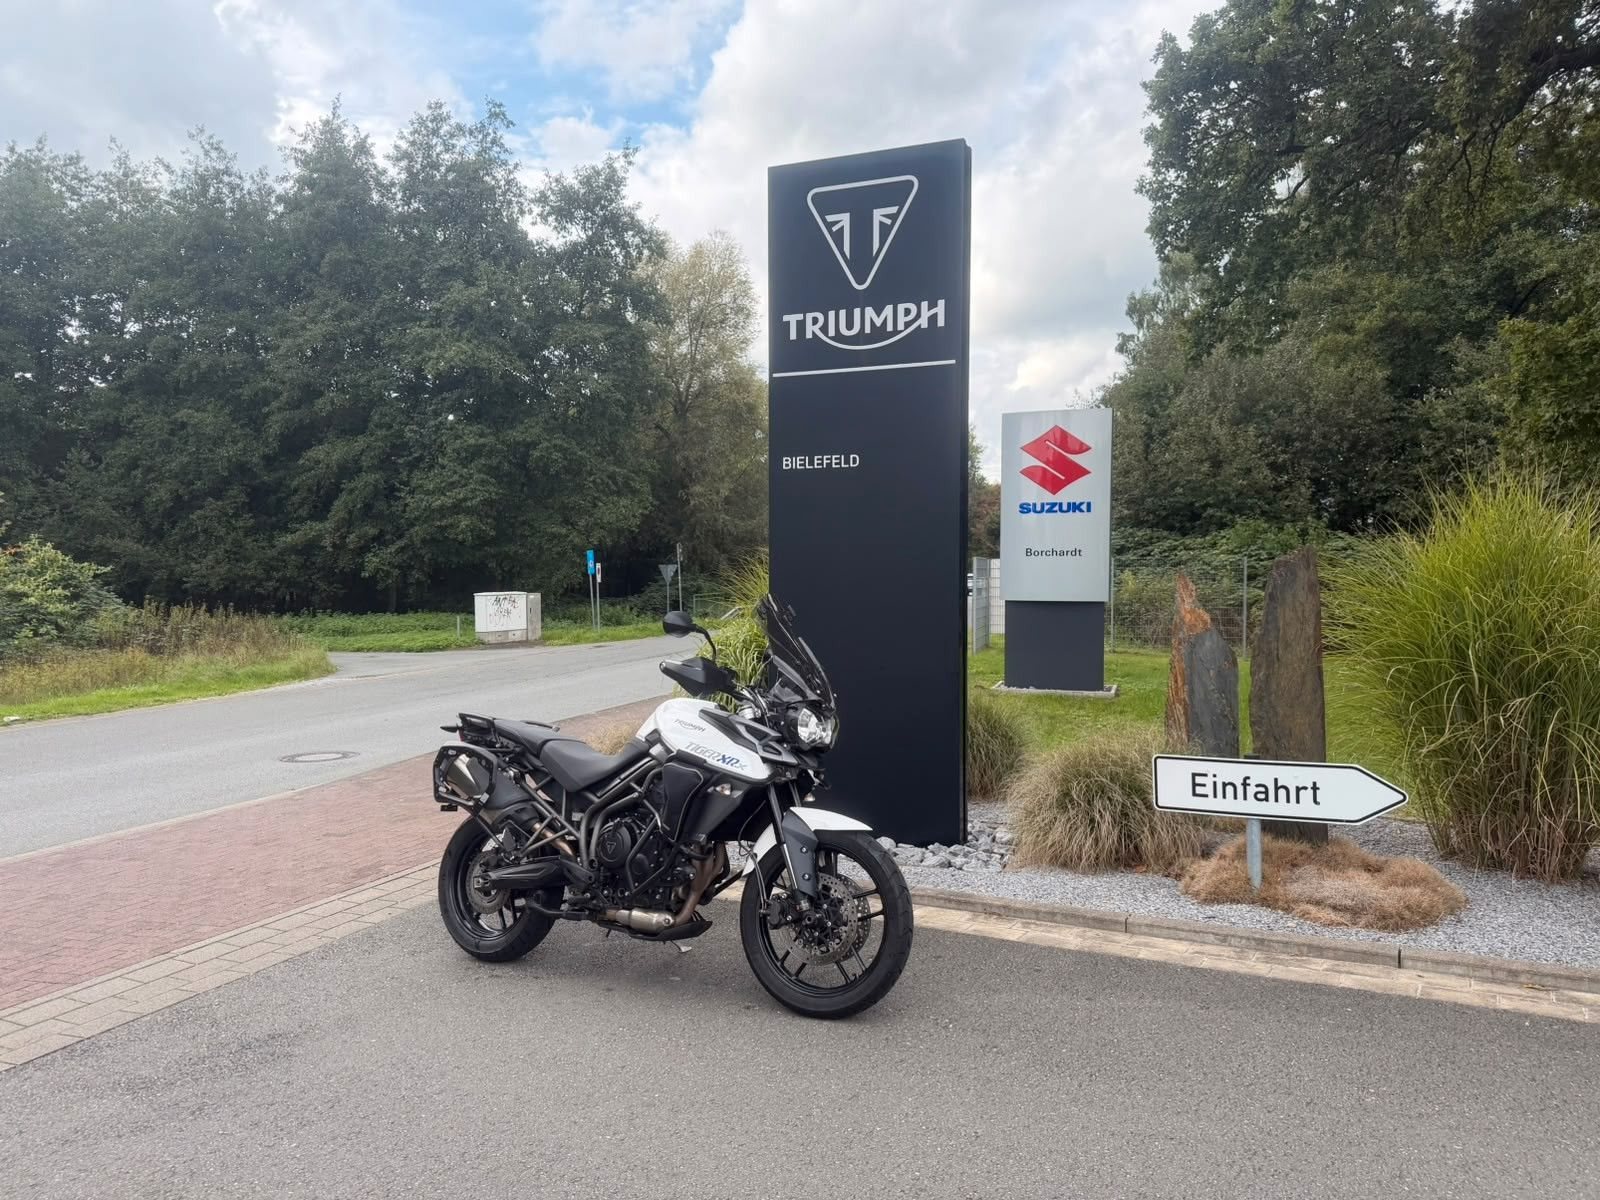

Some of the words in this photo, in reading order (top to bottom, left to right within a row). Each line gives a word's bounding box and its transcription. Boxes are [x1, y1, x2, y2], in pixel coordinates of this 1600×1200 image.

[782, 299, 945, 350] TRIUMPH
[782, 454, 860, 470] BIELEFELD
[1018, 501, 1092, 514] SUZUKI
[1025, 547, 1083, 557] Borchardt
[674, 719, 706, 733] TRIUMPH
[1191, 772, 1320, 806] Einfahrt
